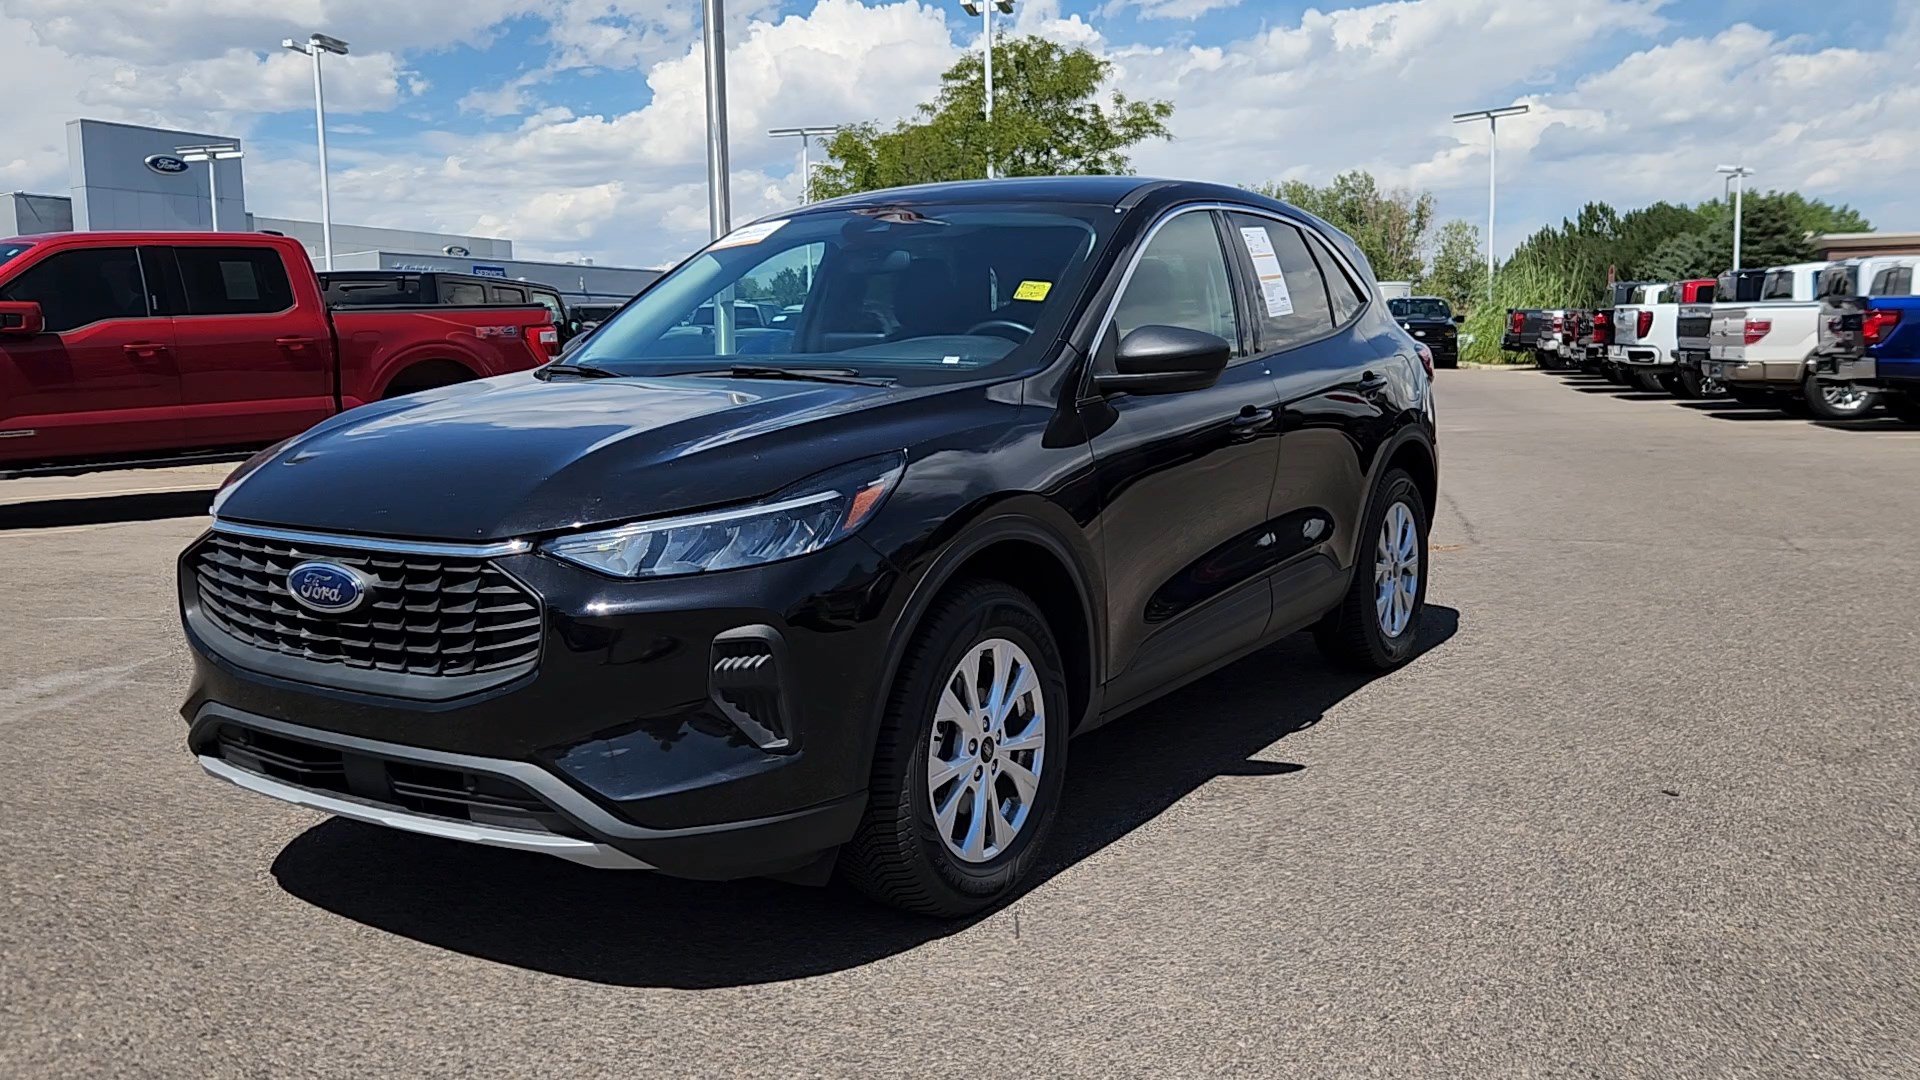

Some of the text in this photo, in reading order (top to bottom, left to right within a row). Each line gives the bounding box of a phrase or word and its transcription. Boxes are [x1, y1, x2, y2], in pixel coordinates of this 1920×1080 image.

[157, 159, 181, 170] Ford
[475, 268, 504, 277] SERVICE
[475, 326, 517, 339] FX4
[301, 572, 342, 601] Ford
